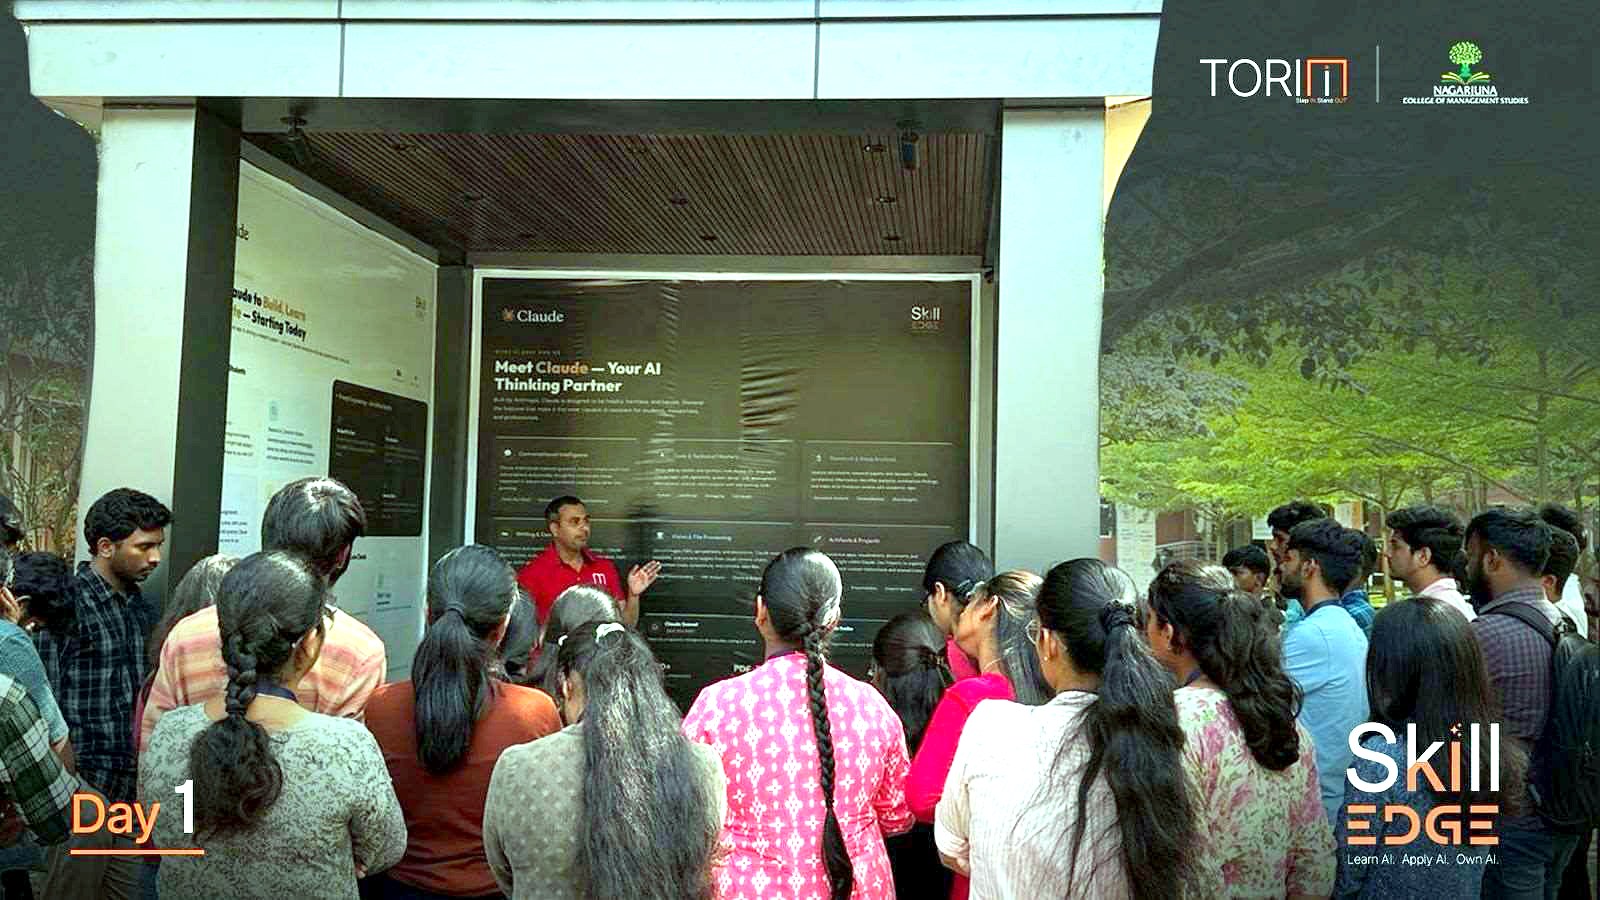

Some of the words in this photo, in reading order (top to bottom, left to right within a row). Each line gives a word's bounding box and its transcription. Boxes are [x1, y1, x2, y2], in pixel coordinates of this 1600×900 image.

[253, 292, 263, 307] to
[516, 309, 565, 323] Claude
[911, 306, 940, 320] Skill
[251, 309, 284, 335] Starting
[284, 320, 306, 342] Today
[495, 360, 534, 374] Meet
[535, 360, 589, 375] Claude
[607, 361, 642, 375] Your
[644, 362, 661, 375] AI
[494, 377, 561, 394] Thinking
[563, 379, 623, 392] Partner
